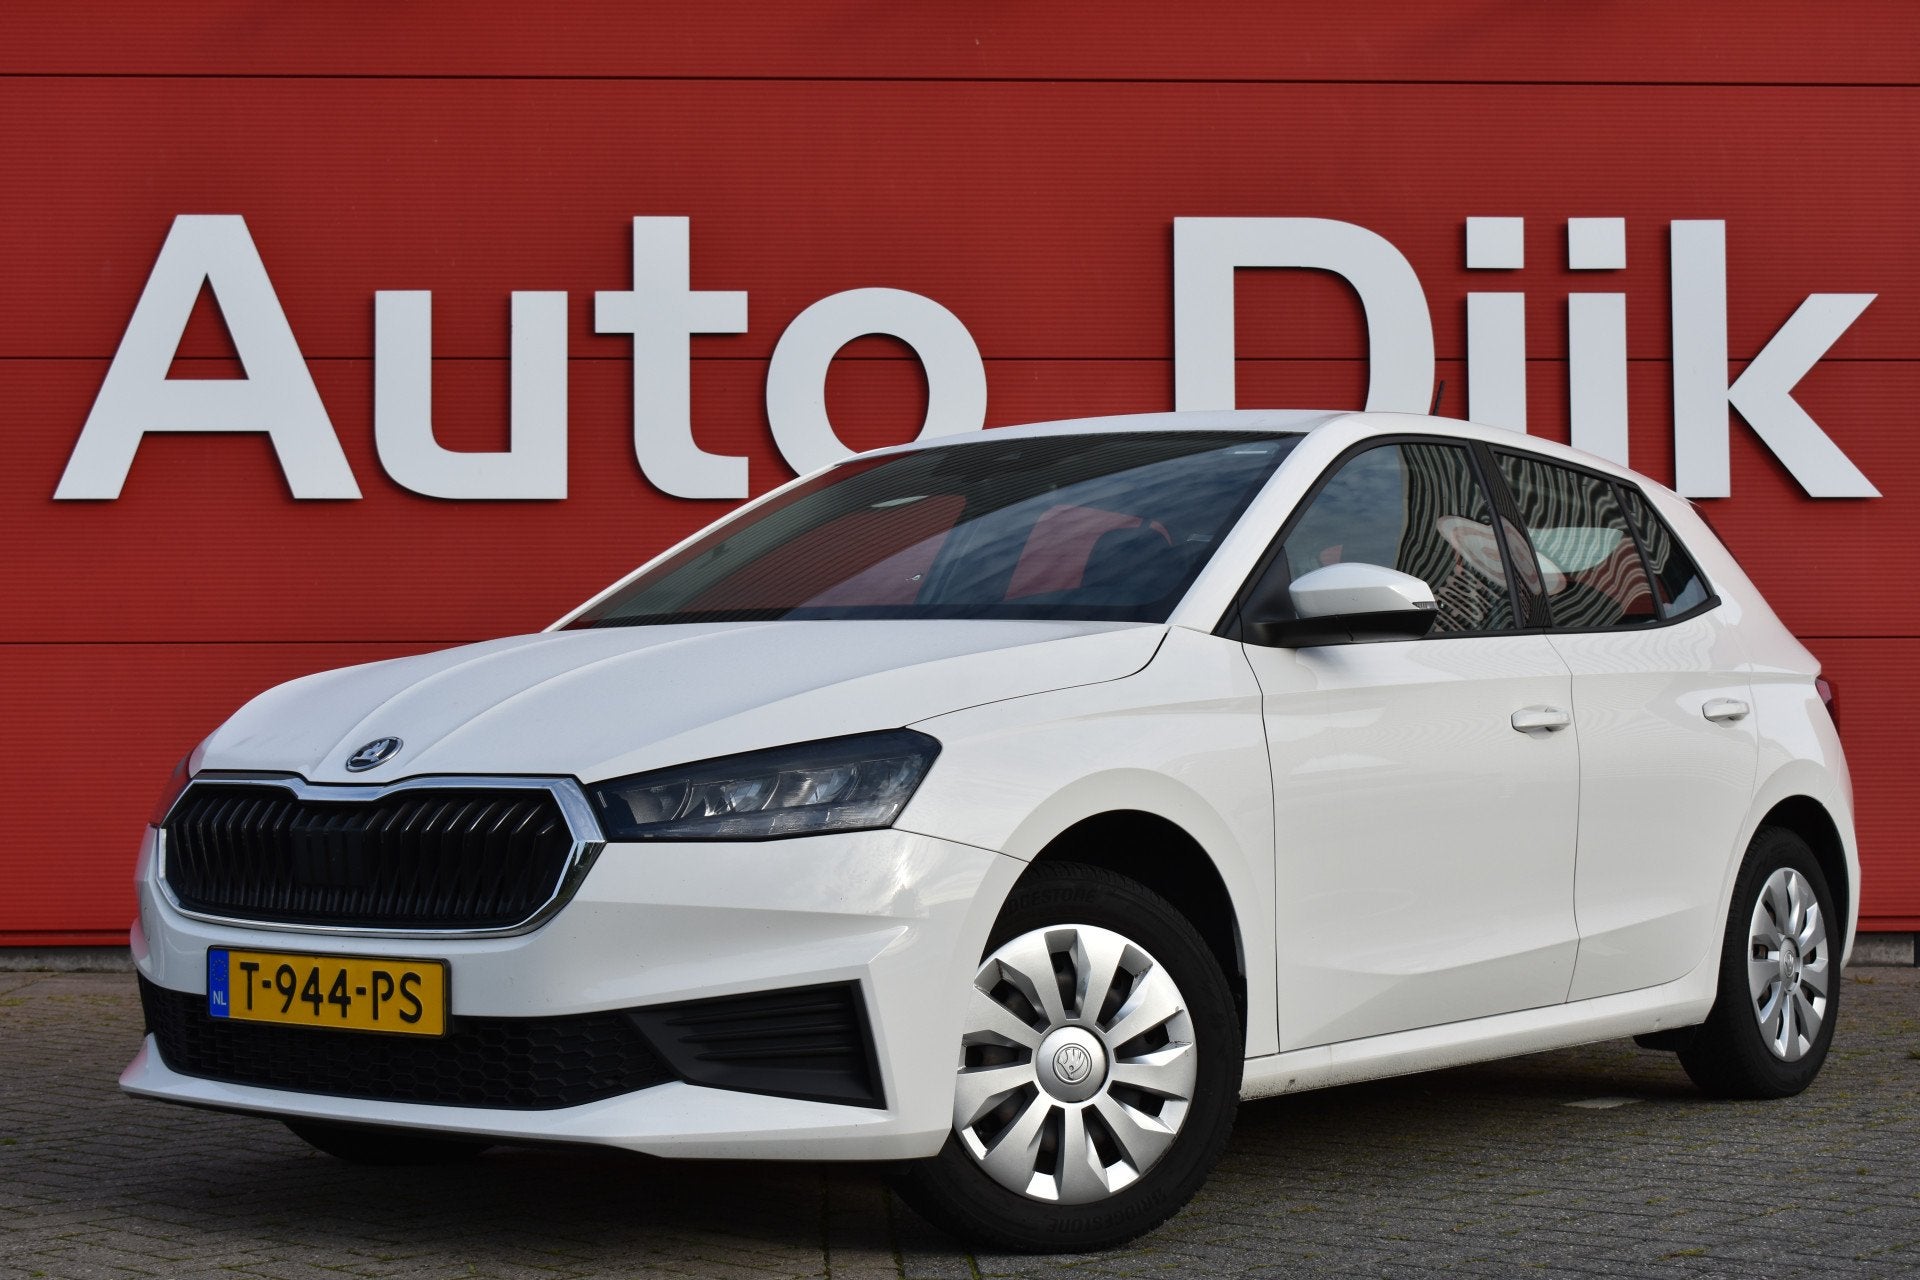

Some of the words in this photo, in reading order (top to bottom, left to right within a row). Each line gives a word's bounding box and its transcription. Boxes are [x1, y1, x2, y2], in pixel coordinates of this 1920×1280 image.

[53, 214, 988, 500] Auto
[1173, 216, 1884, 498] Dijk
[212, 990, 227, 1006] NL
[239, 961, 423, 1024] T-944-PS
